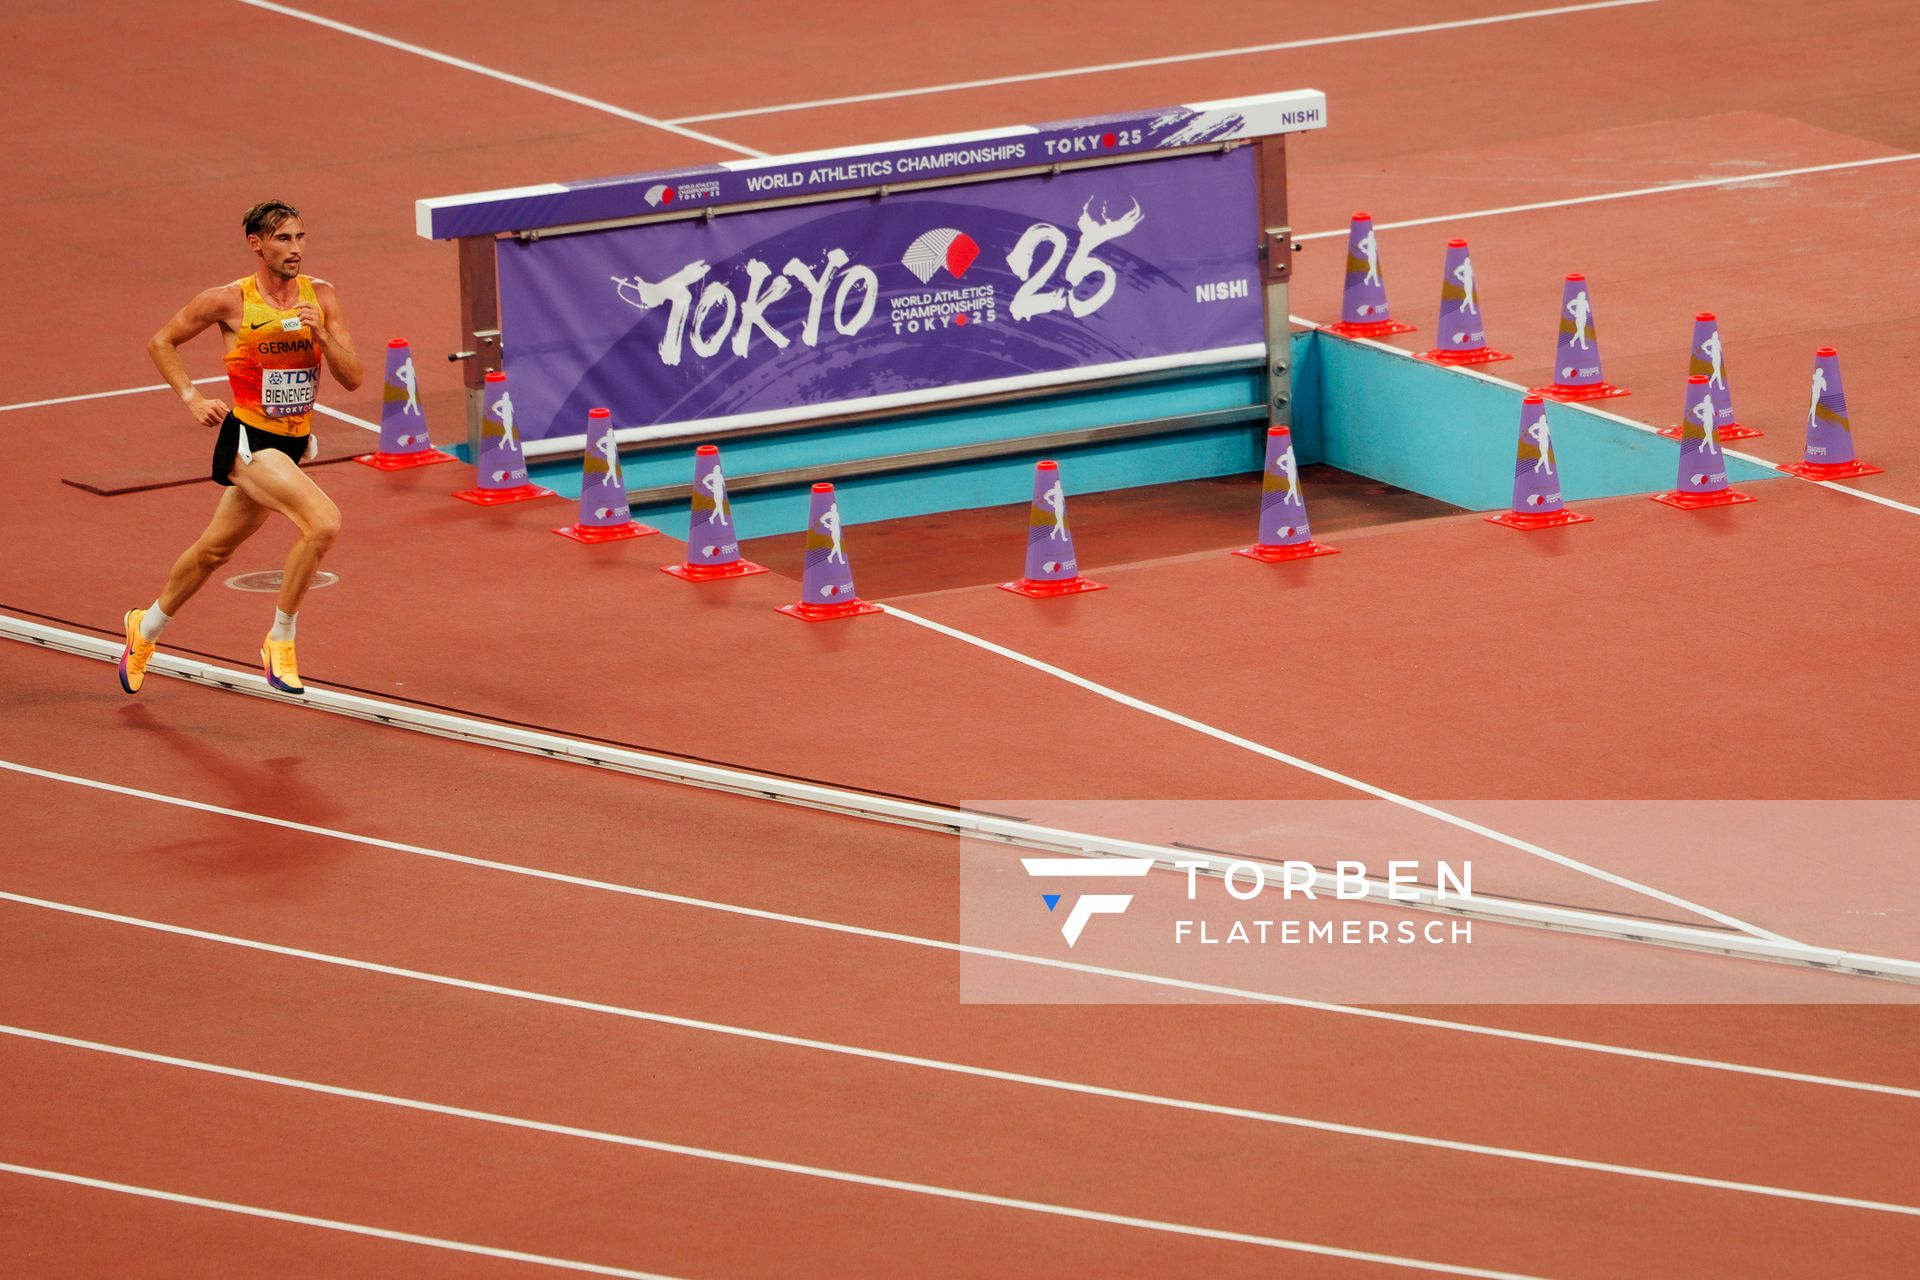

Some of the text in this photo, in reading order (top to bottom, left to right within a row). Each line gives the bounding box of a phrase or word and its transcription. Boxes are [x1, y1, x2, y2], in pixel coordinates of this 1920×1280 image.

[1282, 109, 1319, 125] NISHI
[747, 172, 803, 191] WORLD
[809, 160, 892, 184] ATHLETICS
[897, 144, 1026, 173] CHAMPIONSHIPS
[1118, 130, 1142, 146] 25
[611, 195, 1145, 366] TOKYO 25
[1196, 279, 1248, 303] NISHI
[891, 285, 994, 309] WORLD ATHLETICS
[891, 297, 995, 321] CHAMPIONSHIPS
[972, 310, 996, 324] 25
[258, 340, 314, 354] GERMAN
[283, 369, 317, 384] TDK
